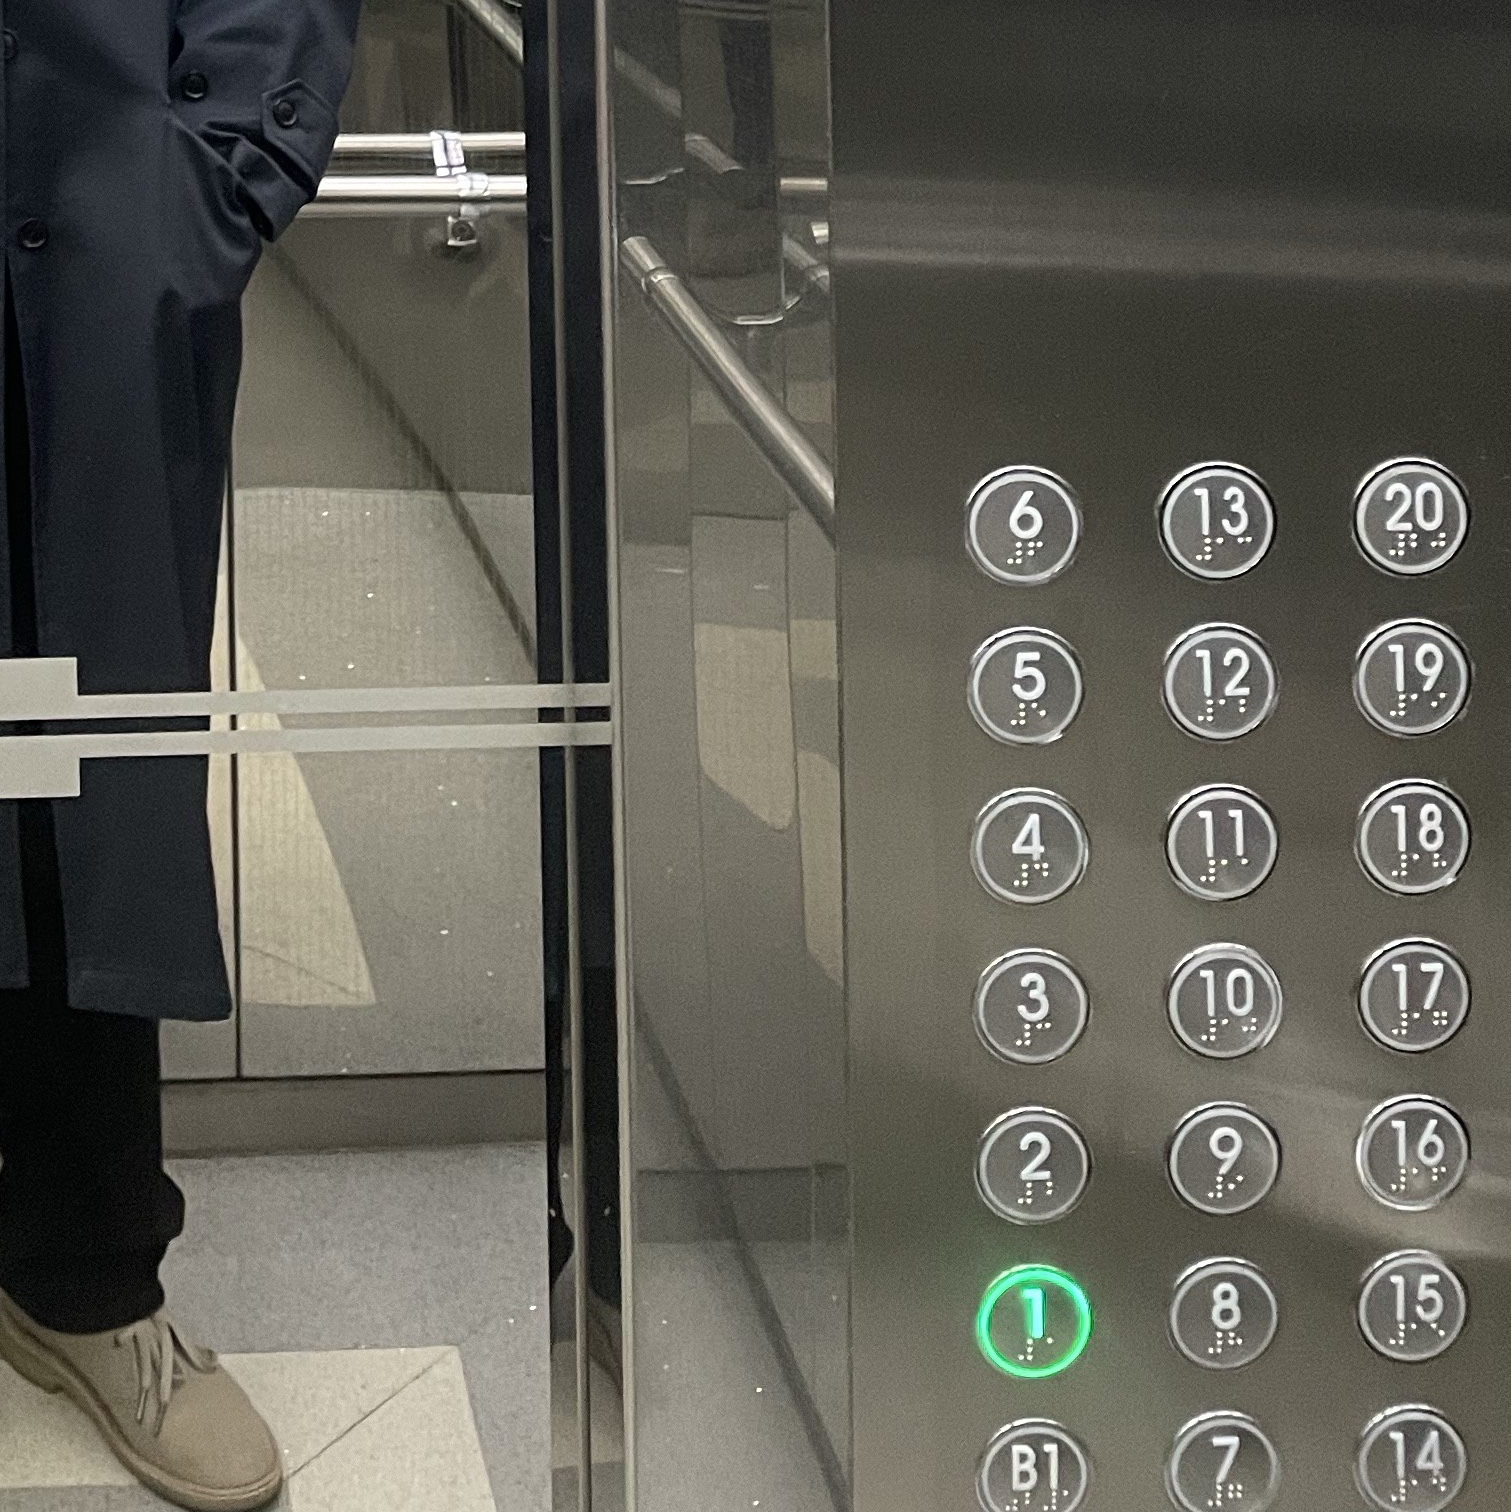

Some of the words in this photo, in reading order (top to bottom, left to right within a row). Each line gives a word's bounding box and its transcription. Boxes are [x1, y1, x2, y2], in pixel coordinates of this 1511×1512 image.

[1008, 491, 1043, 539] 6
[1194, 487, 1249, 537] 13
[1385, 482, 1444, 531] 20
[1012, 651, 1046, 700] 5
[1195, 648, 1250, 697] 12
[1388, 643, 1444, 692] 19
[1012, 812, 1045, 861] 4
[1198, 808, 1244, 858] 11
[1391, 803, 1444, 853] 18
[1017, 972, 1050, 1022] 3
[1199, 968, 1253, 1017] 10
[1392, 962, 1444, 1012] 17
[1019, 1131, 1051, 1182] 2
[1208, 1126, 1243, 1176] 9
[1391, 1119, 1444, 1167] 16
[1021, 1287, 1046, 1339] 1
[1211, 1282, 1241, 1330] 8
[1389, 1274, 1444, 1322] 15
[1011, 1443, 1059, 1492] B1
[1212, 1435, 1240, 1483] 7
[1388, 1431, 1444, 1479] 14
